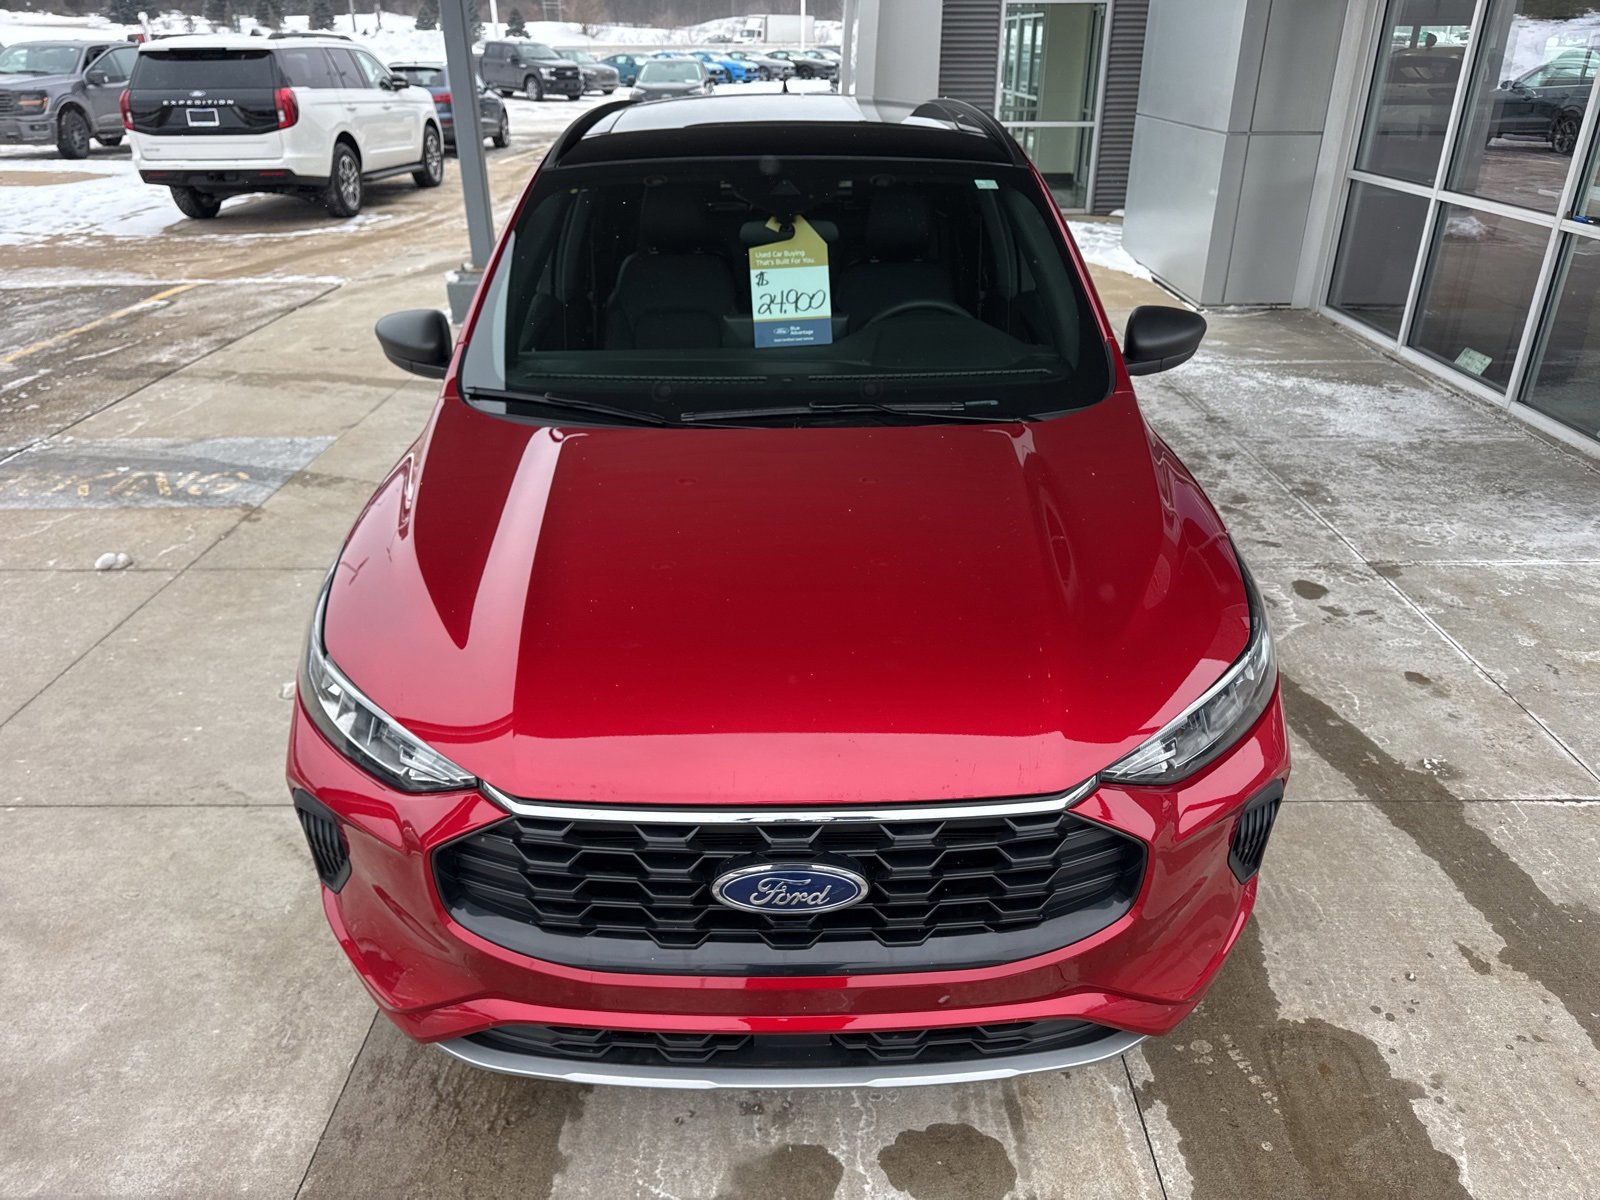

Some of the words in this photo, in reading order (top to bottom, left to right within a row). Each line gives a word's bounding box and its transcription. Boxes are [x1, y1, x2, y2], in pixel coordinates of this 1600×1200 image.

[755, 250, 771, 258] Used
[772, 250, 783, 258] Car
[783, 249, 806, 259] Buying
[756, 259, 775, 267] That's
[775, 258, 790, 266] Built
[790, 257, 801, 265] For
[755, 271, 769, 287] $
[749, 877, 832, 906] Ford
